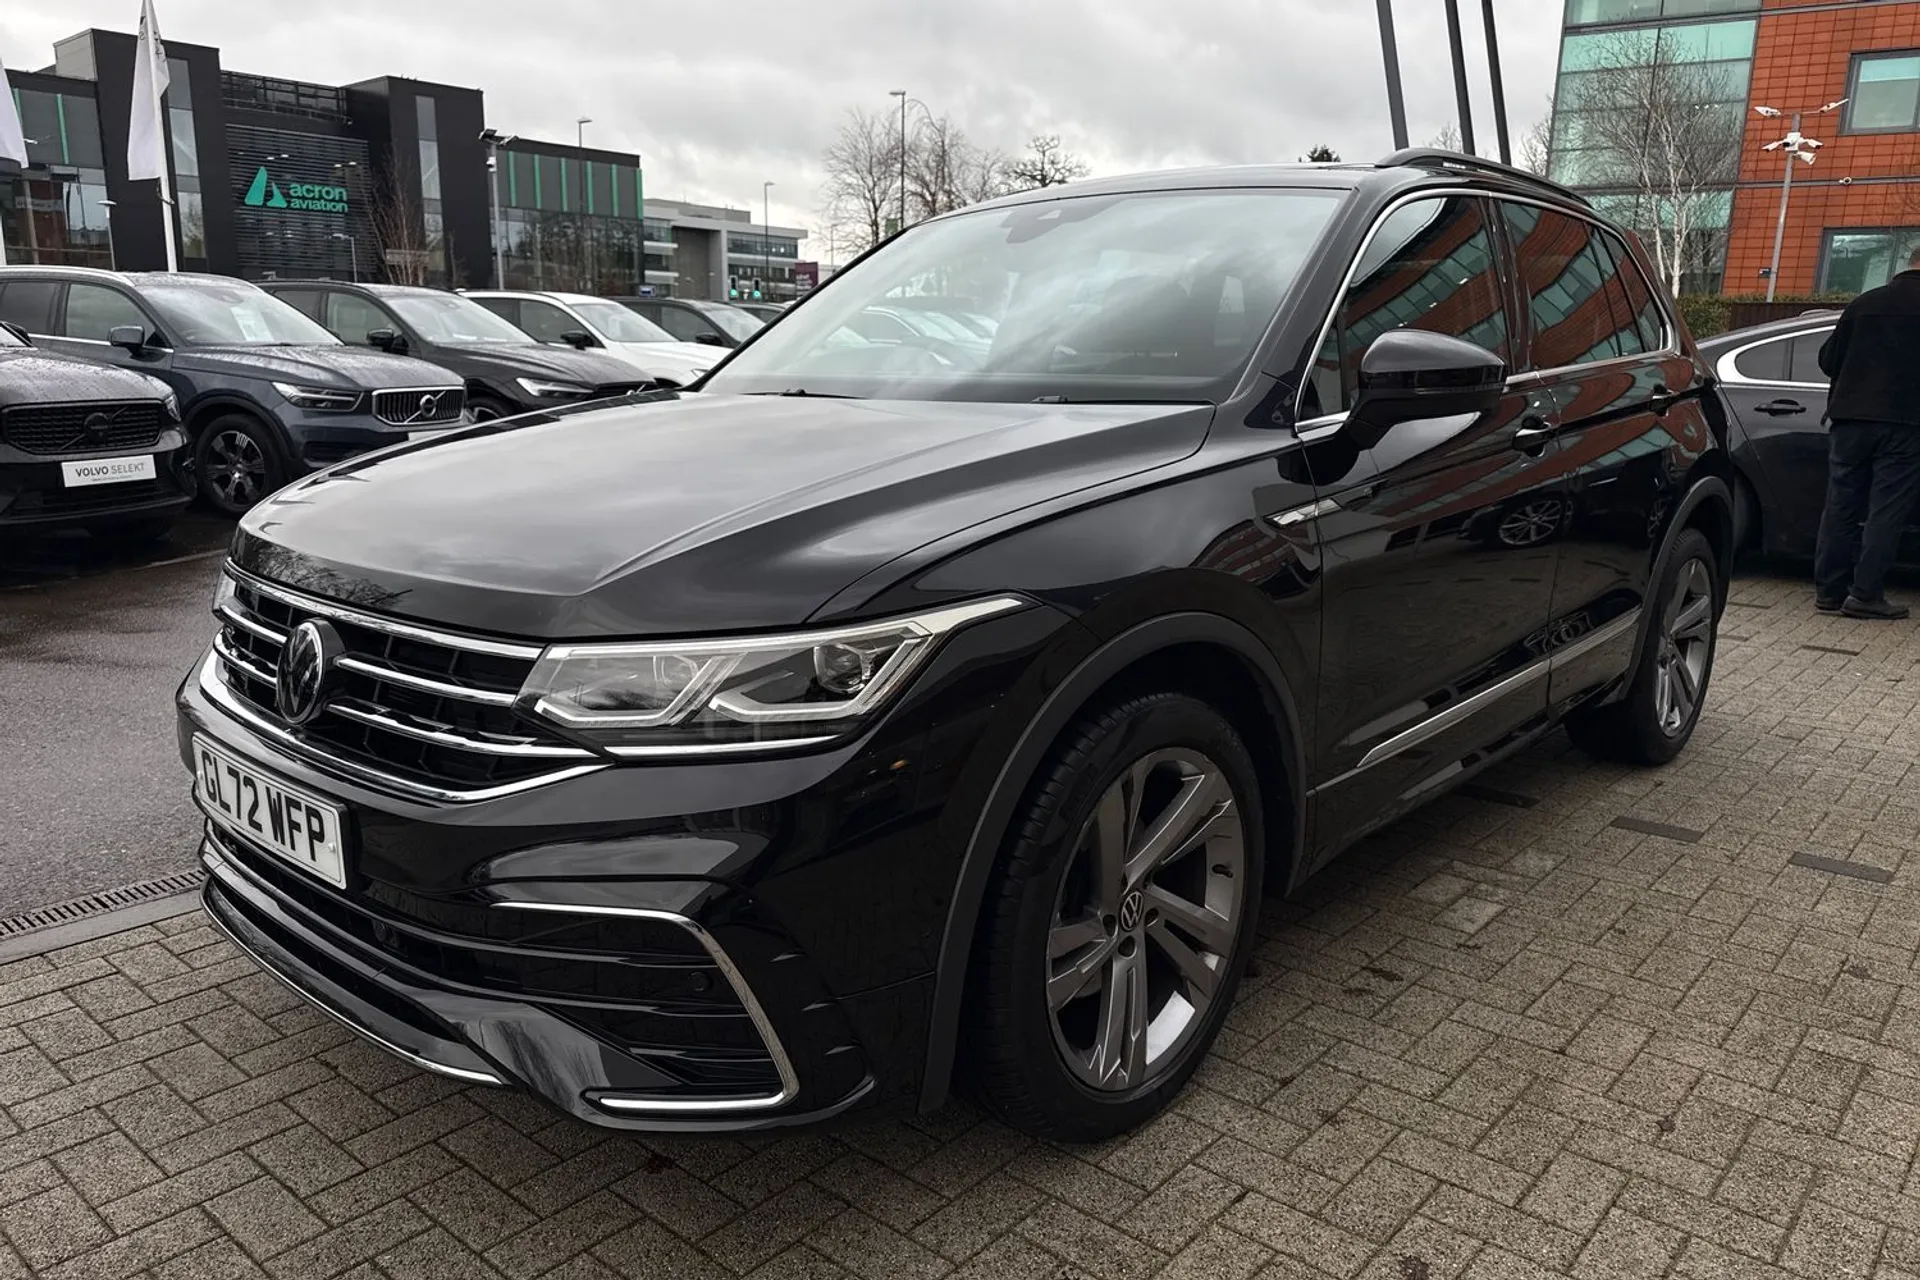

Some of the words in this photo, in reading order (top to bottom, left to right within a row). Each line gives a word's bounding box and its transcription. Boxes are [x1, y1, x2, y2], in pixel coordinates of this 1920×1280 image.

[289, 183, 347, 201] acron
[290, 199, 348, 213] aviation
[75, 466, 109, 477] VOLVO
[111, 463, 144, 475] SELEKT
[202, 750, 263, 833] GL72
[265, 786, 325, 862] WFP
